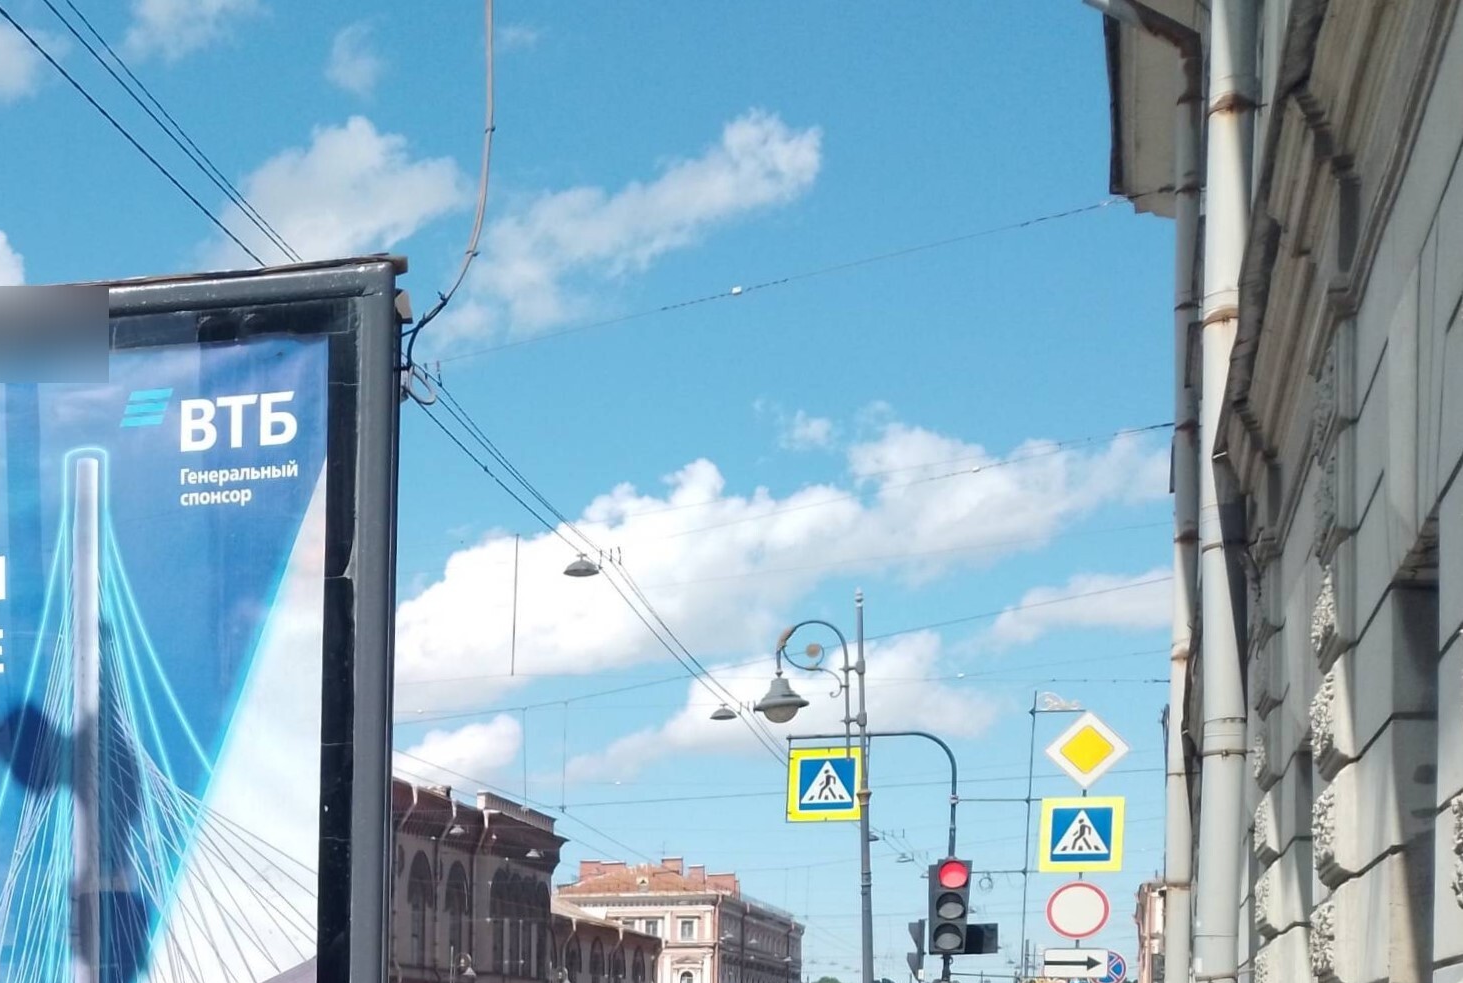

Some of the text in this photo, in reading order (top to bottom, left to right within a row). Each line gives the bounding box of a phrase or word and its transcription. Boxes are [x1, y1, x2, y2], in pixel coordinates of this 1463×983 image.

[180, 391, 298, 453] ВТБ
[180, 459, 299, 486] Генеральный
[180, 488, 252, 507] спонсор
